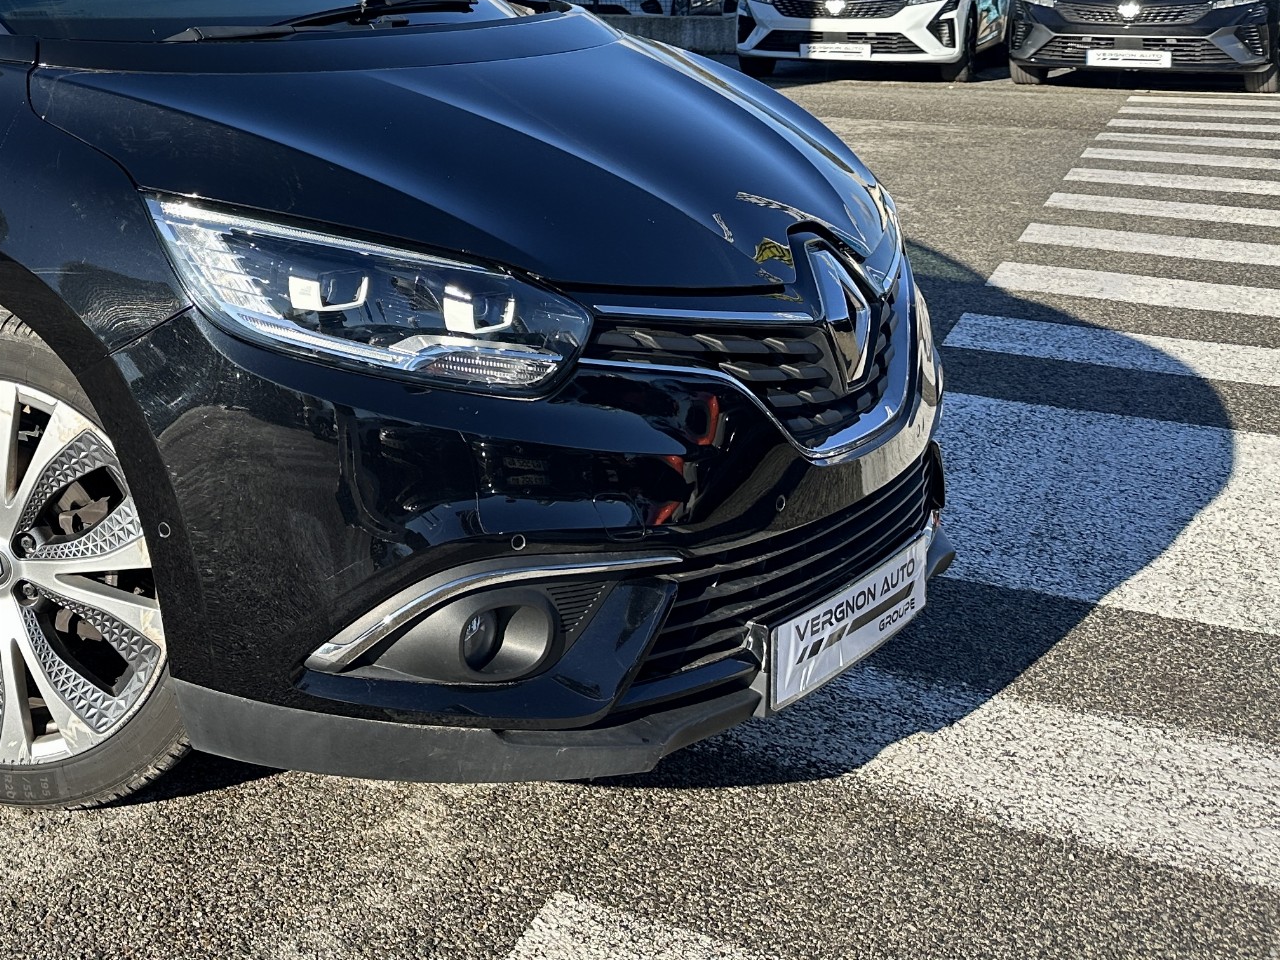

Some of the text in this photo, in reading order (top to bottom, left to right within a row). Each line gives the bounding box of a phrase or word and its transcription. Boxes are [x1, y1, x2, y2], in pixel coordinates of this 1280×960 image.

[795, 558, 915, 642] VERGNON AUTO
[878, 598, 915, 632] GROUPE
